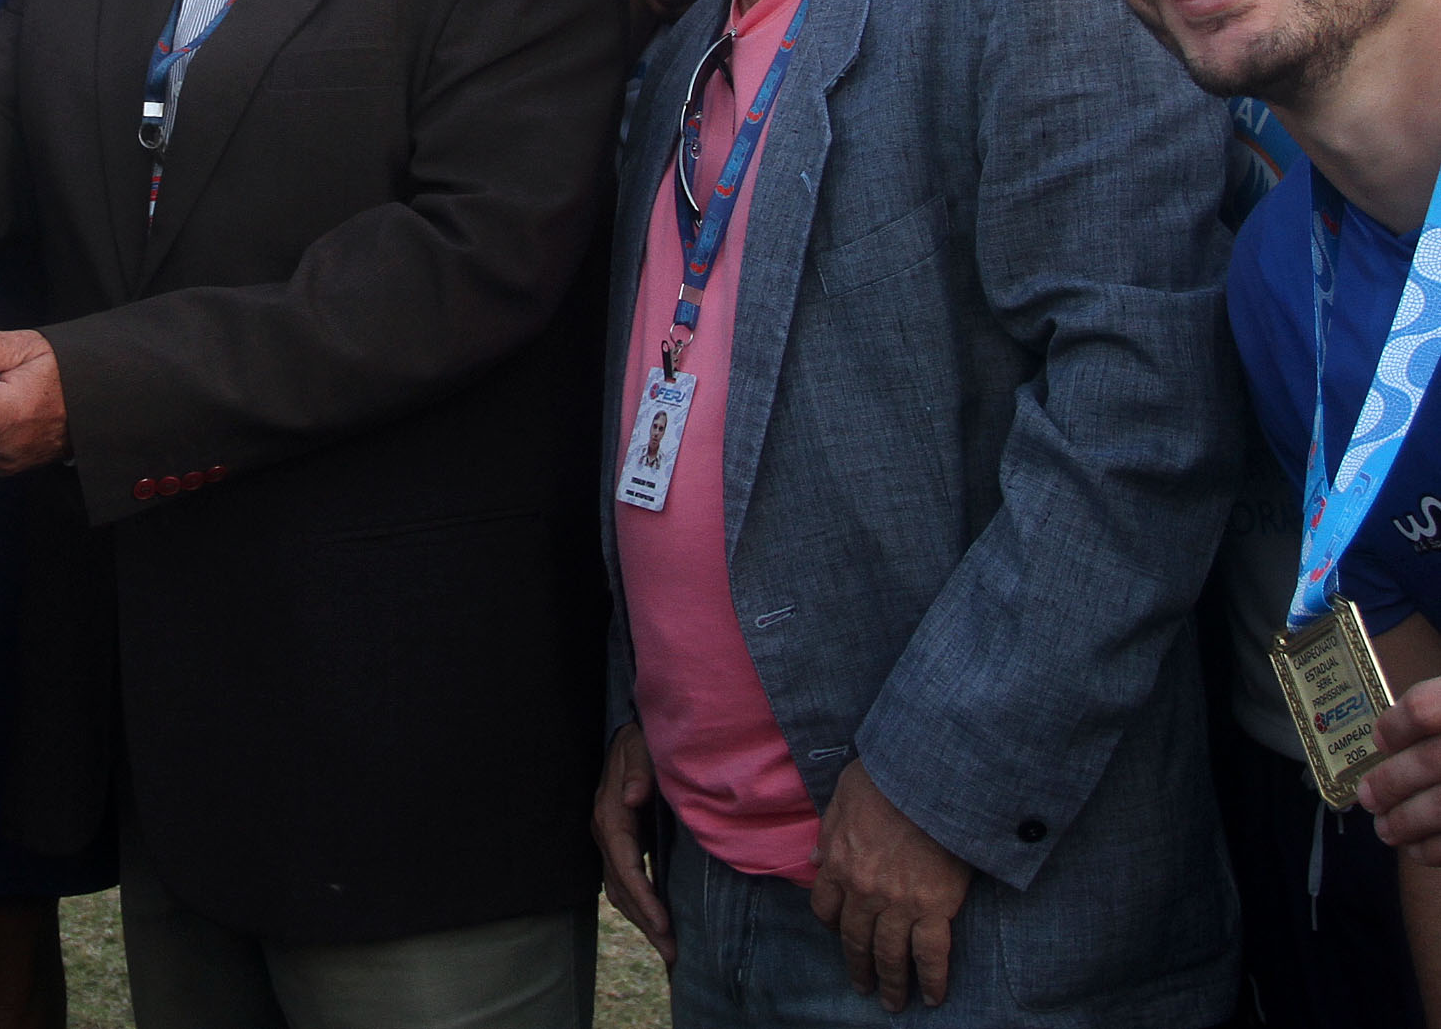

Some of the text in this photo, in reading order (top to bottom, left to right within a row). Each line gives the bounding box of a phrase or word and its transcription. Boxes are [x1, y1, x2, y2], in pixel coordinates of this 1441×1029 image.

[1293, 635, 1338, 671] CAMPEONATO
[1304, 656, 1339, 683] ESTADUAL
[1324, 691, 1368, 727] FERJ
[1327, 723, 1372, 756] CAMPEÃO
[1344, 745, 1367, 766] 2015
